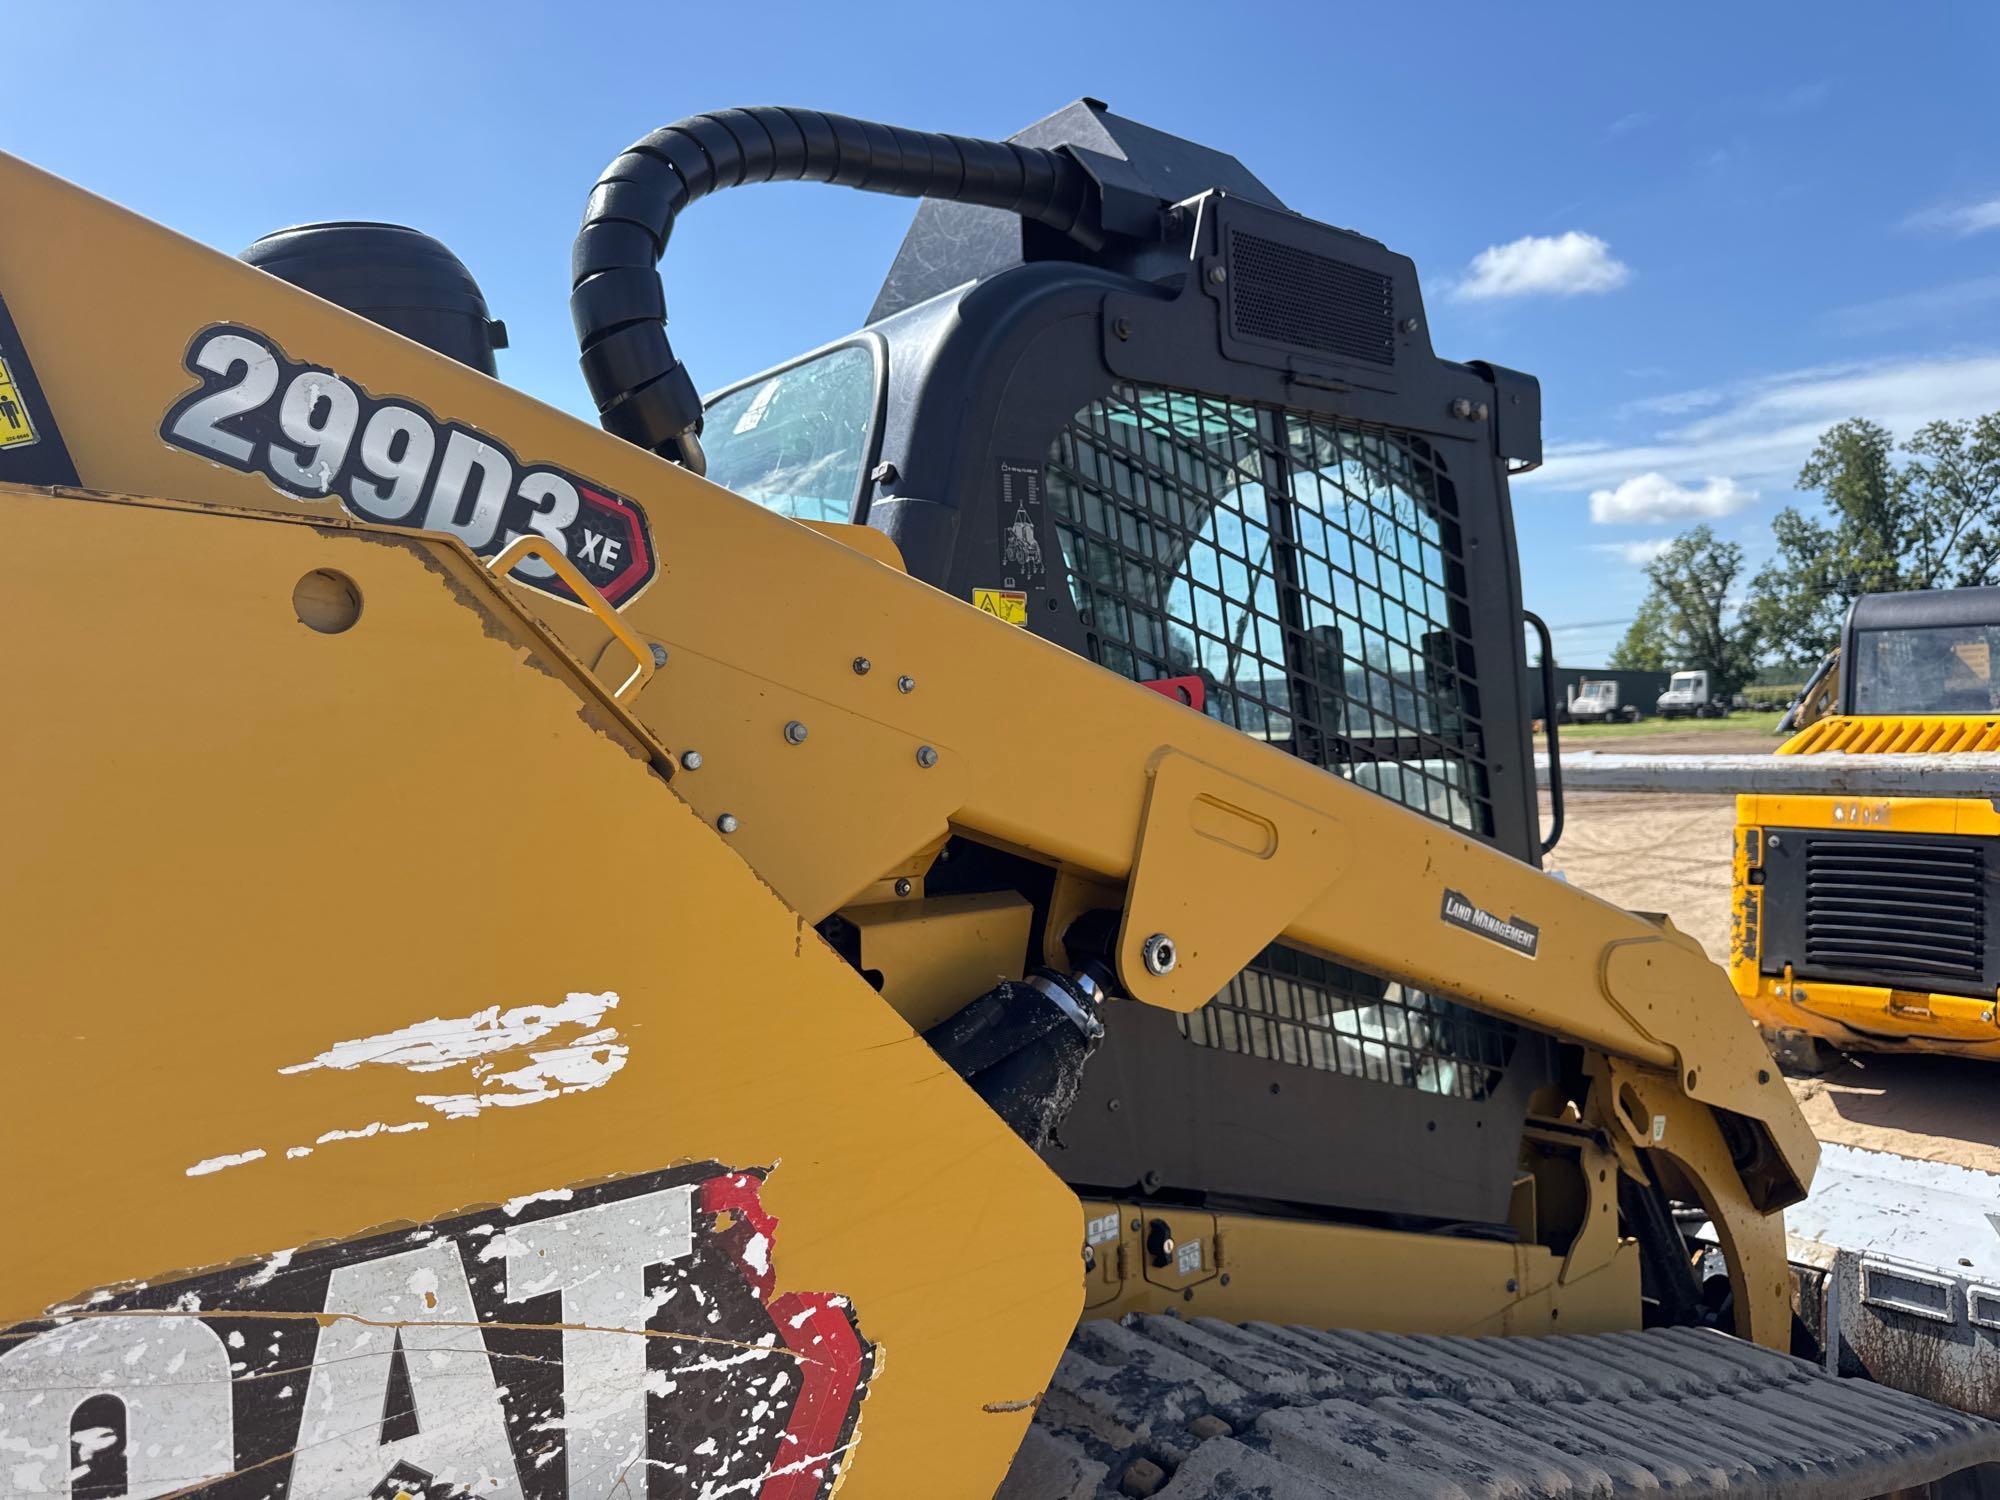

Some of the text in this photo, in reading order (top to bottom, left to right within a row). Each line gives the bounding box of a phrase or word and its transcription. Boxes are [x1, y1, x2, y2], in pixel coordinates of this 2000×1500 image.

[172, 335, 622, 578] 299D3 XE
[1446, 896, 1535, 947] LAND MANAGEMENT
